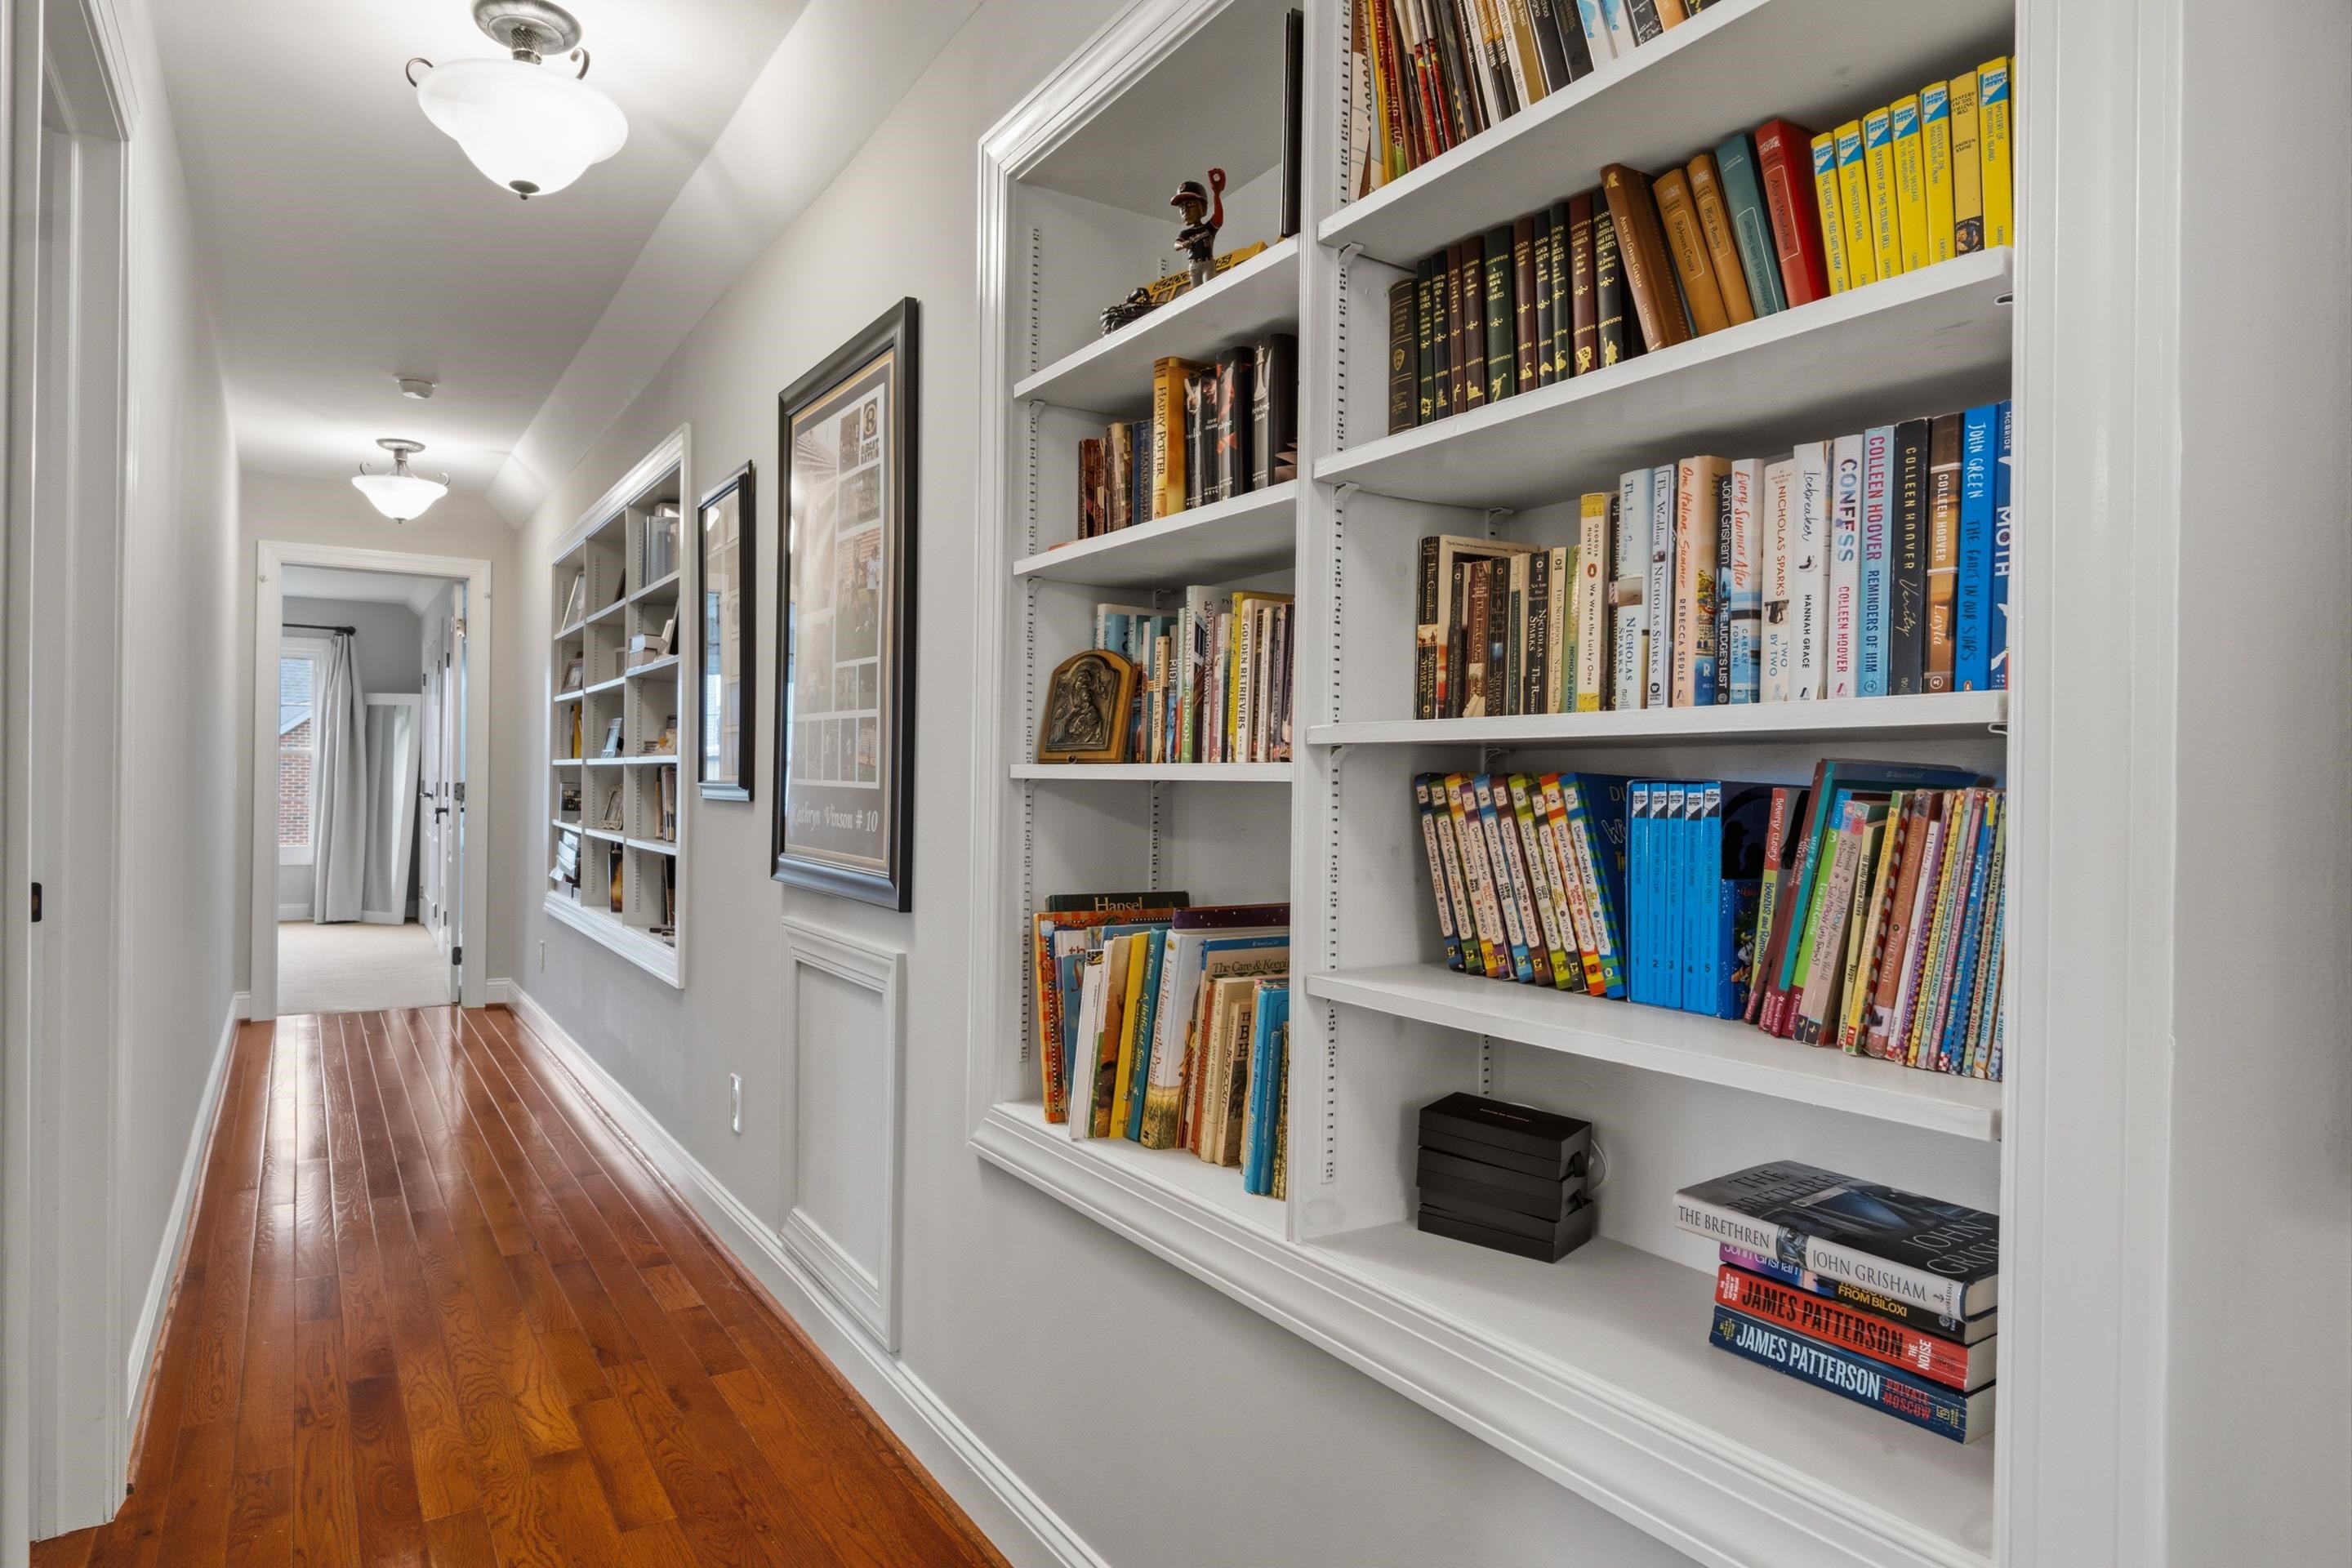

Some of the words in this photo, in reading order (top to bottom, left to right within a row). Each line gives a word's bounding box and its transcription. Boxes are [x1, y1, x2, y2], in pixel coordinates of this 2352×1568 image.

[1152, 271, 1190, 292] SCHOO
[1155, 386, 1167, 428] HARRY
[1155, 430, 1166, 479] POTTER
[1967, 421, 1986, 455] JOHN
[1682, 466, 1694, 487] One
[1867, 435, 1886, 500] COLLEEN
[1904, 446, 1917, 507] COLLEEN
[1967, 457, 1984, 499] GREEN
[1722, 481, 1732, 514] John
[1732, 470, 1751, 506] Every
[1801, 469, 1822, 542] Icebreaker
[1936, 473, 1949, 519] COLLEEN
[1680, 490, 1693, 537] Italian
[1776, 485, 1786, 552] NICHOLAS
[1837, 458, 1858, 563] CONFESS
[1720, 515, 1731, 565] Grisham
[1732, 507, 1750, 559] Summer
[1865, 502, 1883, 562] HOOVER
[1903, 512, 1916, 570] HOOVER
[1935, 521, 1947, 562] HOOVER
[1966, 519, 1980, 544] THE
[1678, 538, 1690, 589] Summer
[1732, 559, 1751, 589] After
[1775, 555, 1786, 598] SPARKS
[1589, 583, 1597, 597] We
[1652, 566, 1664, 630] NICHOLAS
[1838, 586, 1850, 633] COLLEEN
[1867, 570, 1880, 630] REMINDERS
[1895, 578, 1919, 638] Verity
[1963, 585, 1978, 597] IN
[1678, 598, 1686, 649] REBECCA
[1720, 600, 1730, 621] THE
[1802, 594, 1812, 635] HANNAH
[1930, 604, 1948, 646] Layla
[1962, 600, 1979, 621] OUR
[1241, 622, 1250, 670] GOLDEN
[1528, 616, 1537, 653] SPARKS
[1537, 609, 1547, 657] NICHOLAS
[1586, 639, 1596, 662] Lucky
[1625, 617, 1636, 681] NICHOLAS
[1650, 630, 1662, 674] SPARKS
[1771, 633, 1779, 648] BY
[1865, 632, 1878, 653] OF
[1960, 622, 1976, 662] STARS
[1677, 651, 1686, 683] SERLE
[1769, 651, 1778, 677] TWO
[1802, 639, 1811, 669] GRACE
[1836, 634, 1850, 674] HOOVER
[1864, 656, 1877, 673] HIM
[1718, 666, 1728, 689] LIST
[1237, 671, 1248, 730] RETRIEVERS
[823, 802, 853, 831] Vinson
[855, 808, 863, 829] #
[865, 809, 879, 832] 10
[1094, 897, 1143, 911] Hansel
[1213, 962, 1231, 973] The
[1232, 960, 1252, 971] Care
[1253, 960, 1261, 970] &
[1653, 959, 1659, 969] 2
[1668, 960, 1674, 970] 3
[1687, 965, 1693, 974] 4
[1704, 964, 1710, 973] 5
[1678, 1205, 1701, 1227] THE
[1704, 1214, 1771, 1250] BRETHREN
[1812, 1250, 1851, 1276] JOHN
[1855, 1263, 1927, 1302] GRISHAM
[1901, 1218, 1993, 1255] JOHN
[1741, 1281, 1797, 1322] JAMES
[1801, 1301, 1904, 1360] PATTERSON
[1838, 1285, 1871, 1305] FROM
[1872, 1297, 1908, 1317] BILOXI
[1735, 1324, 1788, 1365] JAMES
[1789, 1337, 1881, 1401] PATTERSON
[1917, 1339, 1932, 1371] NOISE
